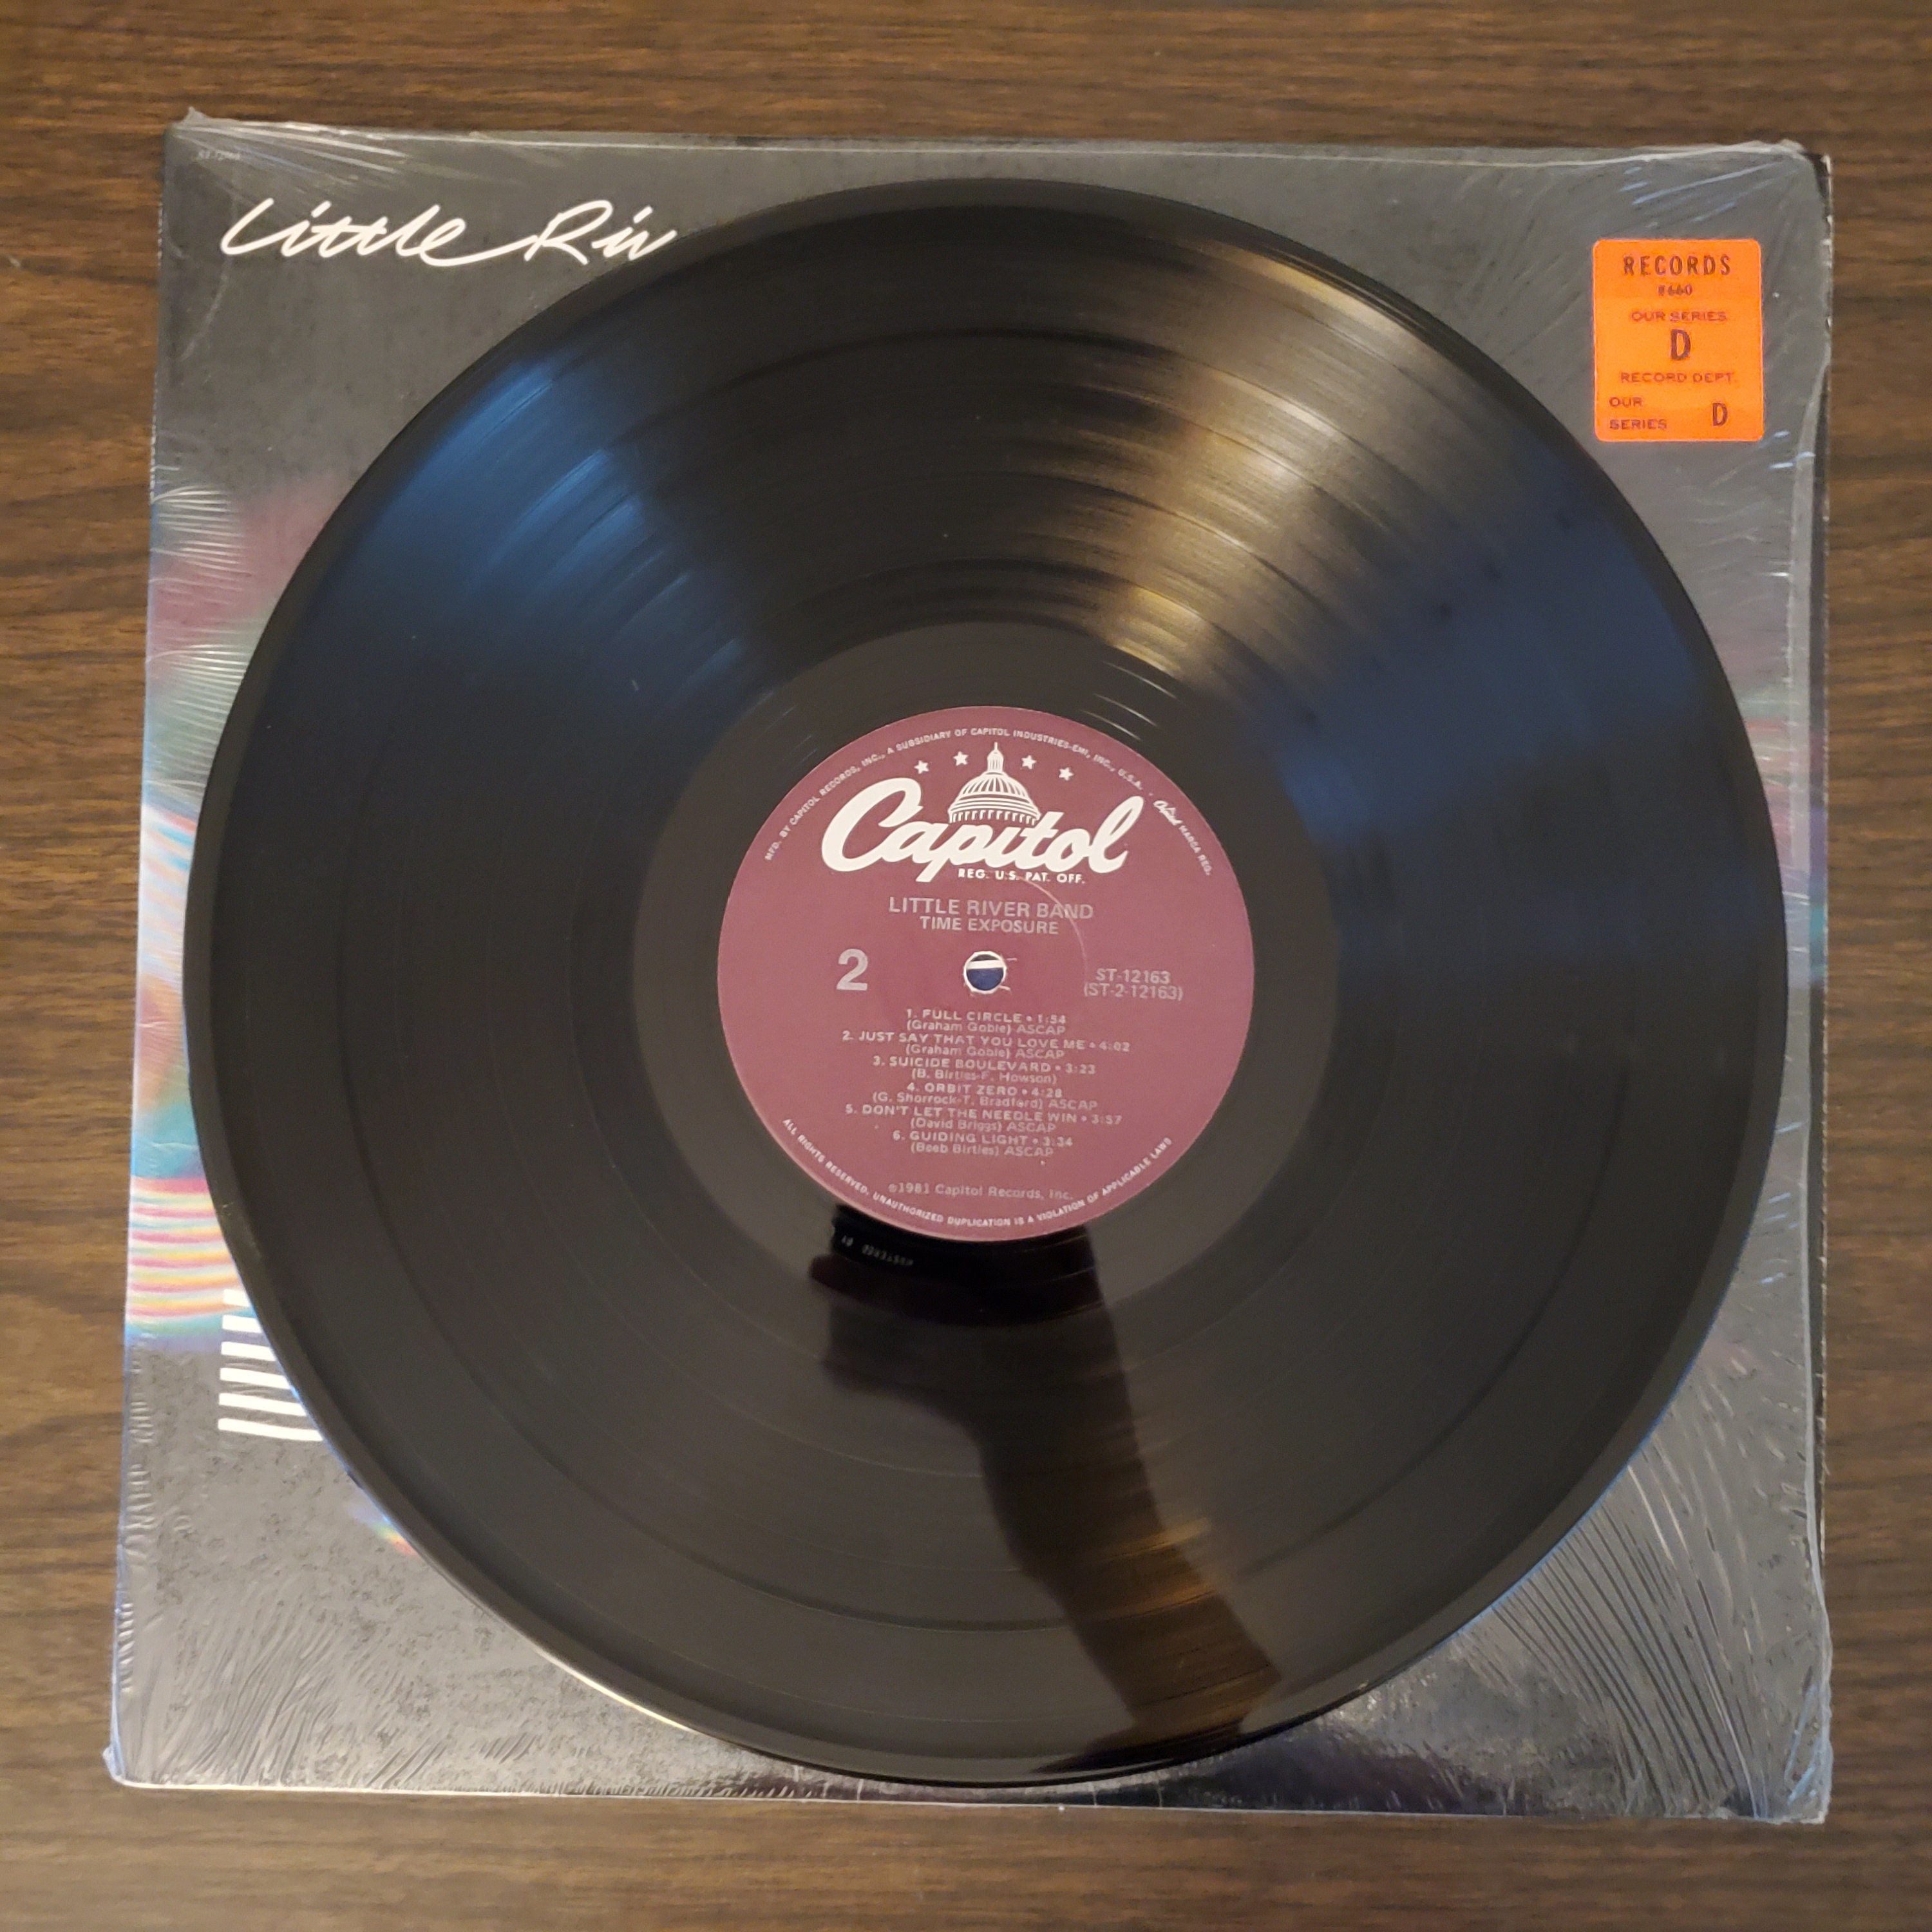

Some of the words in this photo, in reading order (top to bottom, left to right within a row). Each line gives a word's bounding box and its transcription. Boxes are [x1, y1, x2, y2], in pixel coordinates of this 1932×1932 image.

[221, 198, 466, 267] Little
[1623, 254, 1731, 276] RECORDS
[1631, 311, 1666, 322] OUR
[1669, 311, 1728, 323] SERIES
[1670, 328, 1691, 361] D
[1620, 372, 1687, 384] RECORD
[1609, 397, 1643, 408] OUR
[1712, 402, 1728, 427] D
[1609, 419, 1667, 430] SERIES
[764, 840, 782, 860] MFD.
[779, 825, 791, 838] BY
[790, 796, 821, 825] CAPITOL
[819, 766, 862, 796] RECORDS,
[896, 730, 951, 751] SUBSIDIARY
[954, 728, 967, 737] OF
[970, 728, 1011, 736] CAPITOL
[821, 777, 1144, 882] Capitol
[1179, 825, 1202, 854] MARCA
[1198, 854, 1212, 876] REG.
[958, 868, 988, 879] REG.
[995, 869, 1019, 880] U.S.
[1025, 871, 1050, 882] PAT.
[1057, 873, 1086, 884] OFF.
[889, 896, 960, 915] LITTLE
[967, 900, 1030, 918] RIVER
[1036, 902, 1094, 920] BAND
[920, 916, 962, 931] TIME
[967, 918, 1059, 935] EXPOSURE
[836, 948, 869, 991] 2
[1095, 968, 1171, 984] ST-12163
[1083, 982, 1184, 1001] (ST-2-12163)
[906, 1009, 918, 1019] 1.
[922, 1009, 962, 1021] FULL
[967, 1011, 1023, 1023] CIRCLE
[1037, 1014, 1066, 1024] 1:54
[907, 1019, 963, 1031] (Graham
[1016, 1024, 1066, 1034] ASCAP
[842, 1030, 854, 1041] 2.
[858, 1031, 895, 1042] JUST
[898, 1032, 929, 1043] SAY
[934, 1034, 975, 1045] THAT
[980, 1036, 1012, 1048] YOU
[1018, 1037, 1059, 1049] LOVE
[1063, 1039, 1085, 1050] ME
[905, 1043, 962, 1056] (Graham
[1015, 1048, 1065, 1059] ASCAP
[873, 1056, 885, 1066] 3.
[889, 1056, 950, 1068] SUICIDE
[955, 1058, 1052, 1073] BOULEVARD
[911, 1068, 930, 1080] (B.
[999, 1072, 1057, 1084] Howson)
[907, 1082, 920, 1092] 4.
[924, 1083, 971, 1094] ORBIT
[976, 1084, 1018, 1096] ZERO
[873, 1092, 893, 1103] (G.
[980, 1096, 1043, 1110] Bradford)
[1048, 1099, 1098, 1111] ASCAP
[846, 1104, 858, 1114] 5.
[862, 1104, 909, 1115] DON'T
[914, 1106, 943, 1117] LET
[947, 1108, 978, 1119] THE
[982, 1110, 1043, 1122] NEEDLE
[1048, 1113, 1077, 1123] WIN
[911, 1117, 954, 1129] (David
[958, 1119, 1002, 1133] Briggs)
[1007, 1122, 1056, 1133] ASCAP
[893, 1130, 905, 1141] 6.
[909, 1131, 976, 1143] GUIDING
[981, 1134, 1028, 1146] LIGHT
[911, 1142, 949, 1154] (Beeb
[1004, 1146, 1054, 1157] ASCAP
[782, 1119, 798, 1135] ALL
[797, 1134, 826, 1163] RIGHTS
[872, 1191, 944, 1223] UNAUTHORIZED
[947, 1216, 1010, 1227] DUPLICATION
[1014, 1216, 1025, 1225] IS
[1036, 1199, 1086, 1221] VIOLATION
[1086, 1191, 1099, 1204] OF
[1101, 1157, 1151, 1197] APPLICABLE
[1150, 1137, 1173, 1159] LAWS
[934, 1184, 983, 1197] Capitol
